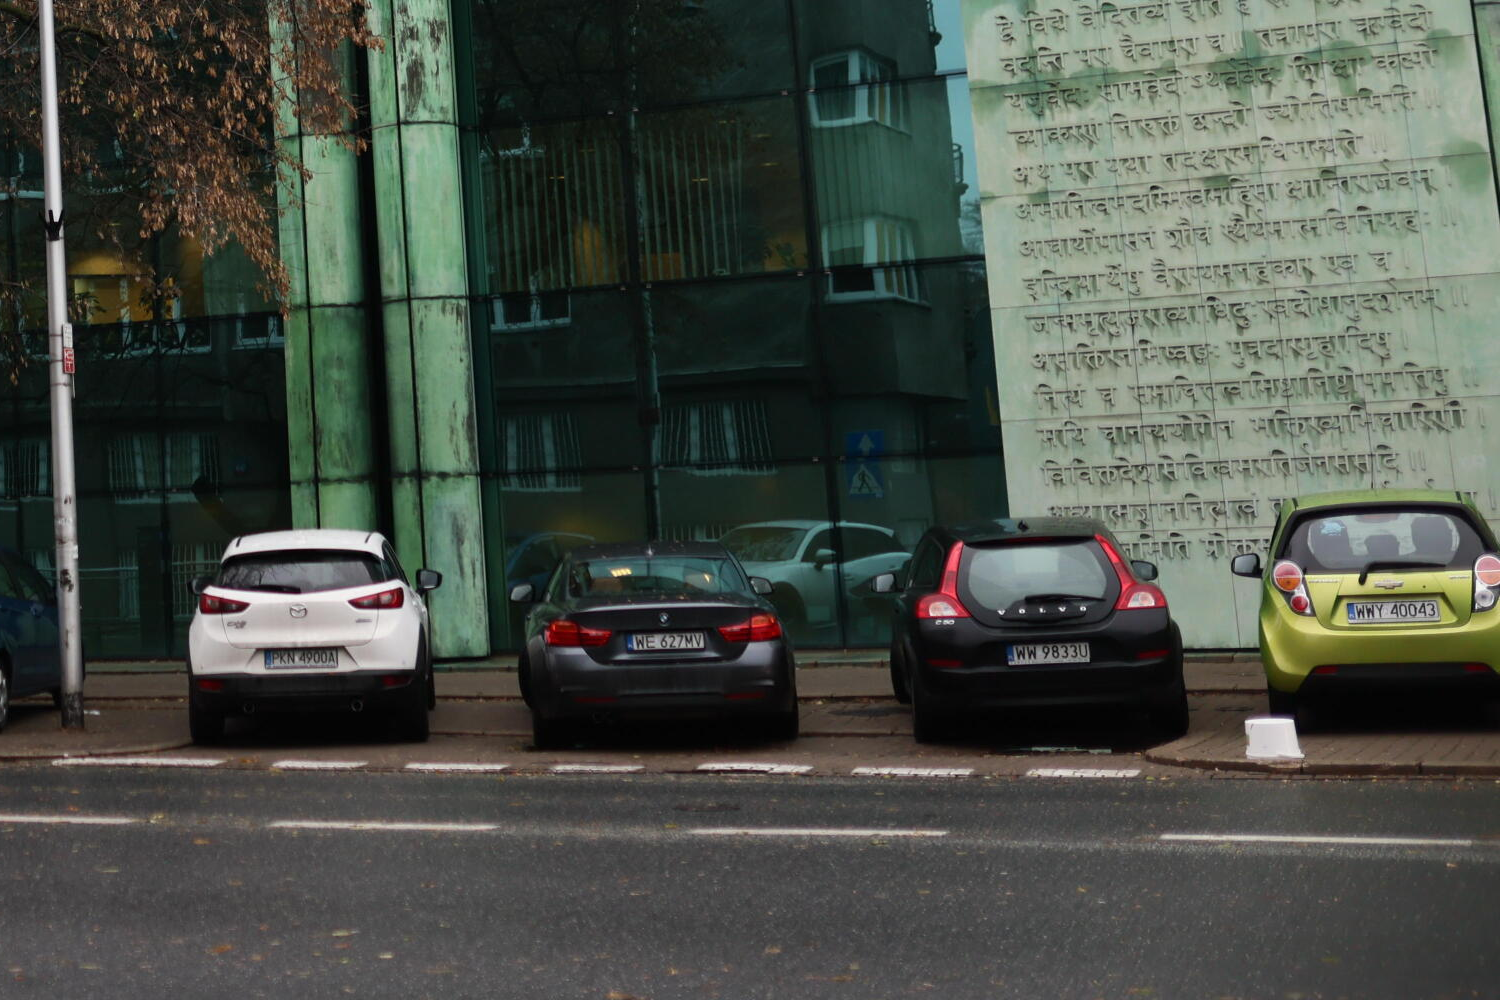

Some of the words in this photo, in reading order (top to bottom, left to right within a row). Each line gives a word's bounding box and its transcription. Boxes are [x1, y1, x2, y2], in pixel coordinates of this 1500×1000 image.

[1073, 47, 1112, 69] परा
[1205, 34, 1225, 54] च
[1059, 160, 1099, 182] परा
[1320, 254, 1359, 277] एव
[1367, 252, 1393, 272] च
[1095, 387, 1117, 407] च
[997, 606, 1087, 616] VOLVO
[1355, 604, 1383, 618] WWY
[1390, 603, 1436, 617] 40043
[636, 635, 656, 649] WE
[660, 634, 702, 649] 627MV
[272, 651, 296, 665] PKN
[299, 650, 336, 664] 4900A
[1015, 646, 1037, 660] WW
[1042, 644, 1088, 659] 9833U
